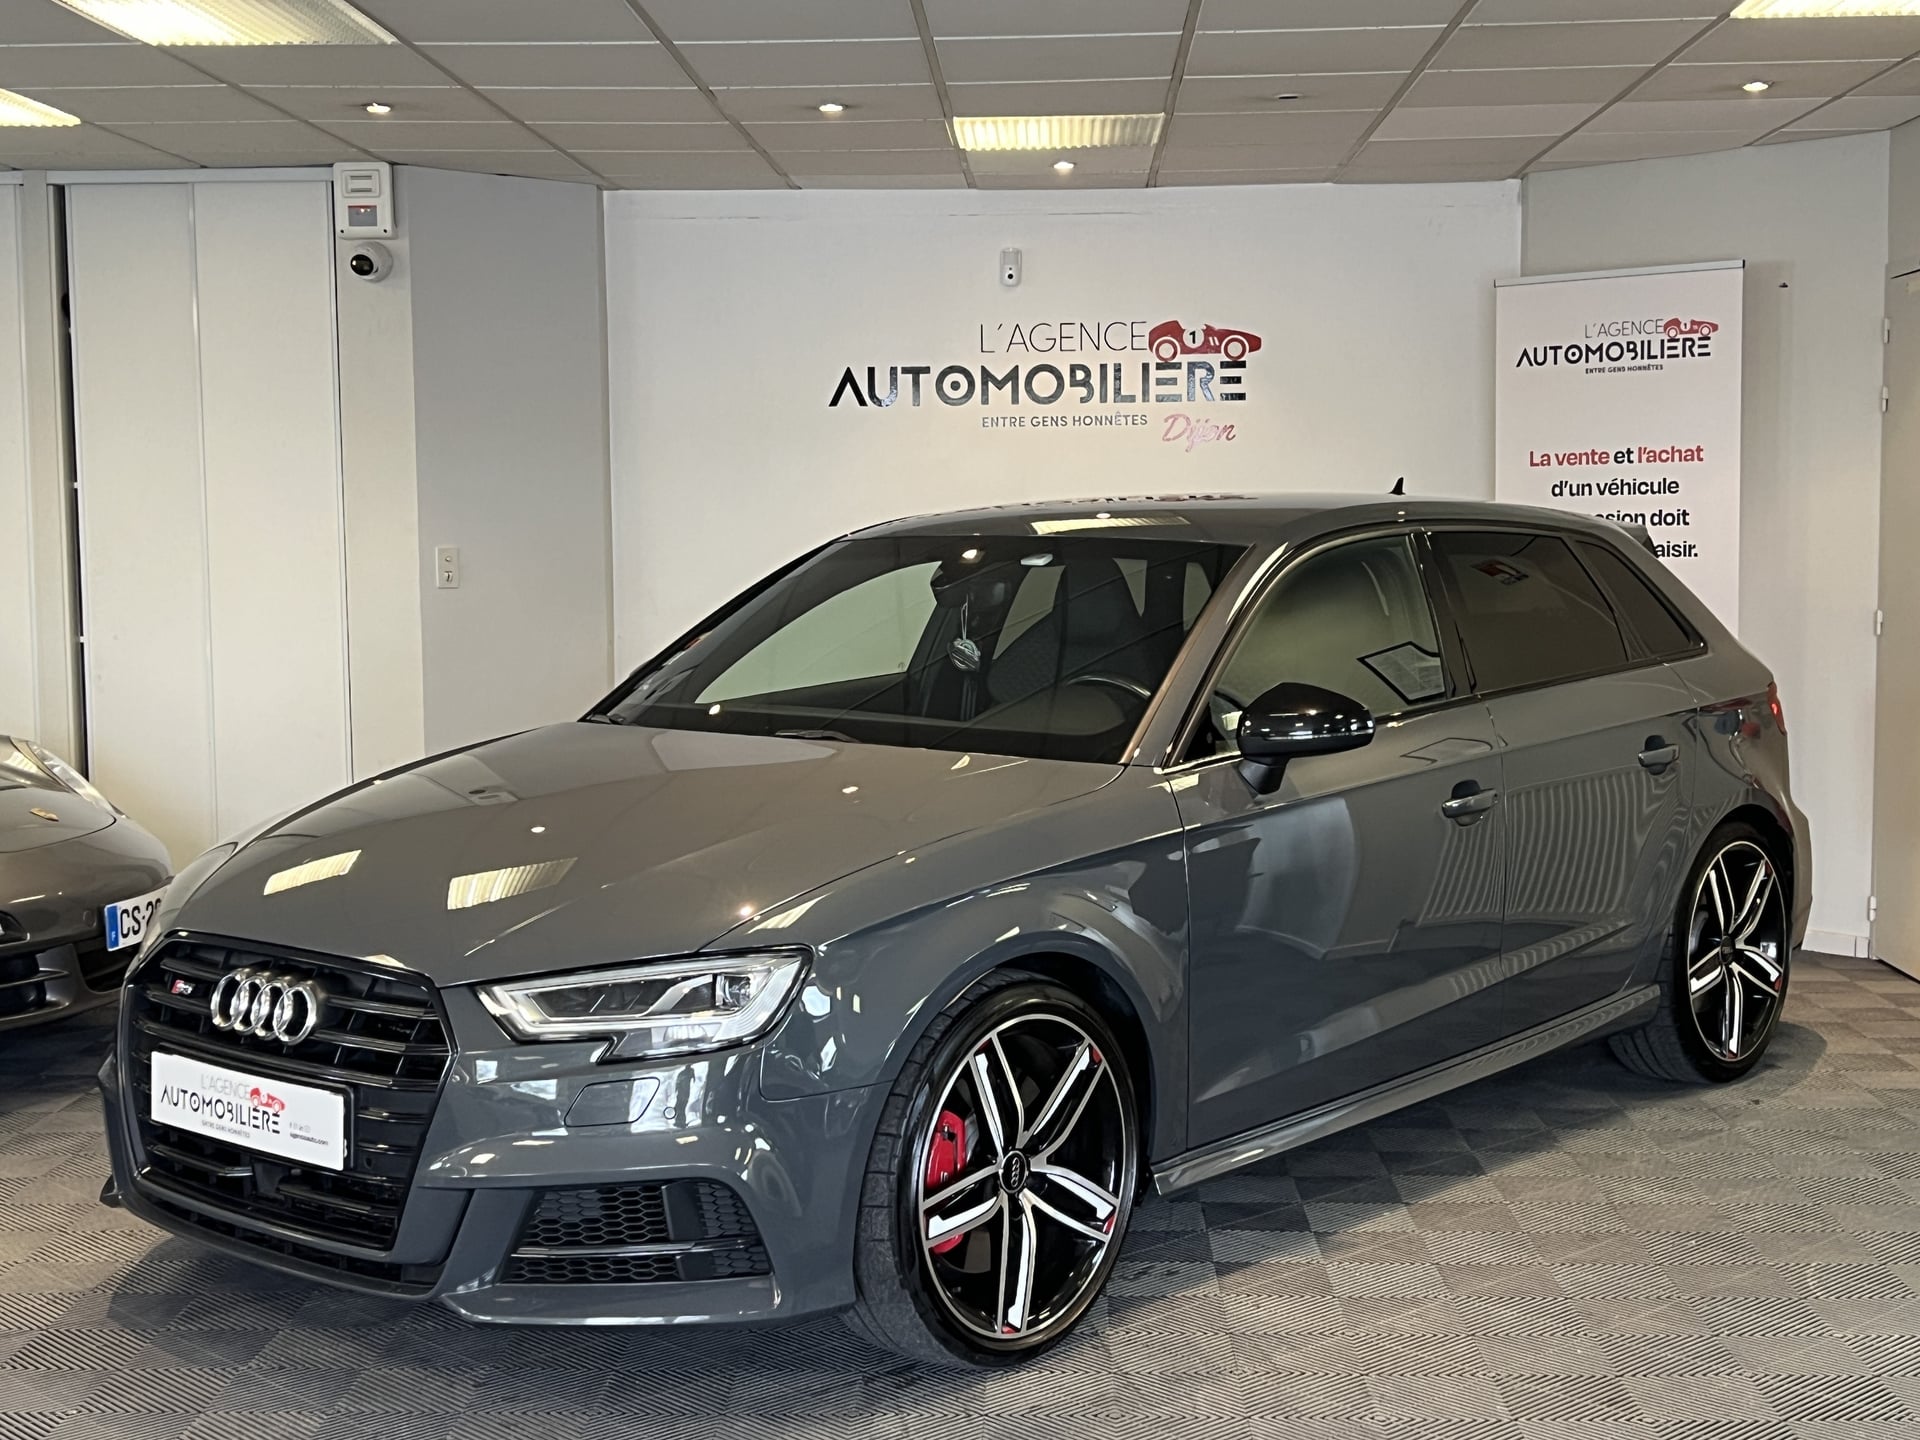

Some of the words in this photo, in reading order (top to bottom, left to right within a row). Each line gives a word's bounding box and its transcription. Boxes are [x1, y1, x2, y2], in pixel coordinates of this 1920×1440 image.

[979, 321, 1148, 354] L'AGENCE
[1188, 330, 1196, 344] 1
[1584, 319, 1664, 339] L'AGENCE
[982, 415, 1026, 428] ENTRE
[1030, 414, 1068, 428] GENS
[1072, 410, 1148, 427] HONNÊTES
[1161, 413, 1236, 453] Dijon
[1529, 451, 1551, 467] La
[1554, 449, 1610, 466] vente
[1613, 447, 1634, 465] et
[1637, 445, 1704, 463] l'achat
[1551, 480, 1593, 497] d'un
[1596, 477, 1680, 496] véhicule
[1595, 510, 1646, 526] sion
[1650, 509, 1690, 526] doit
[1655, 540, 1699, 558] aisir.
